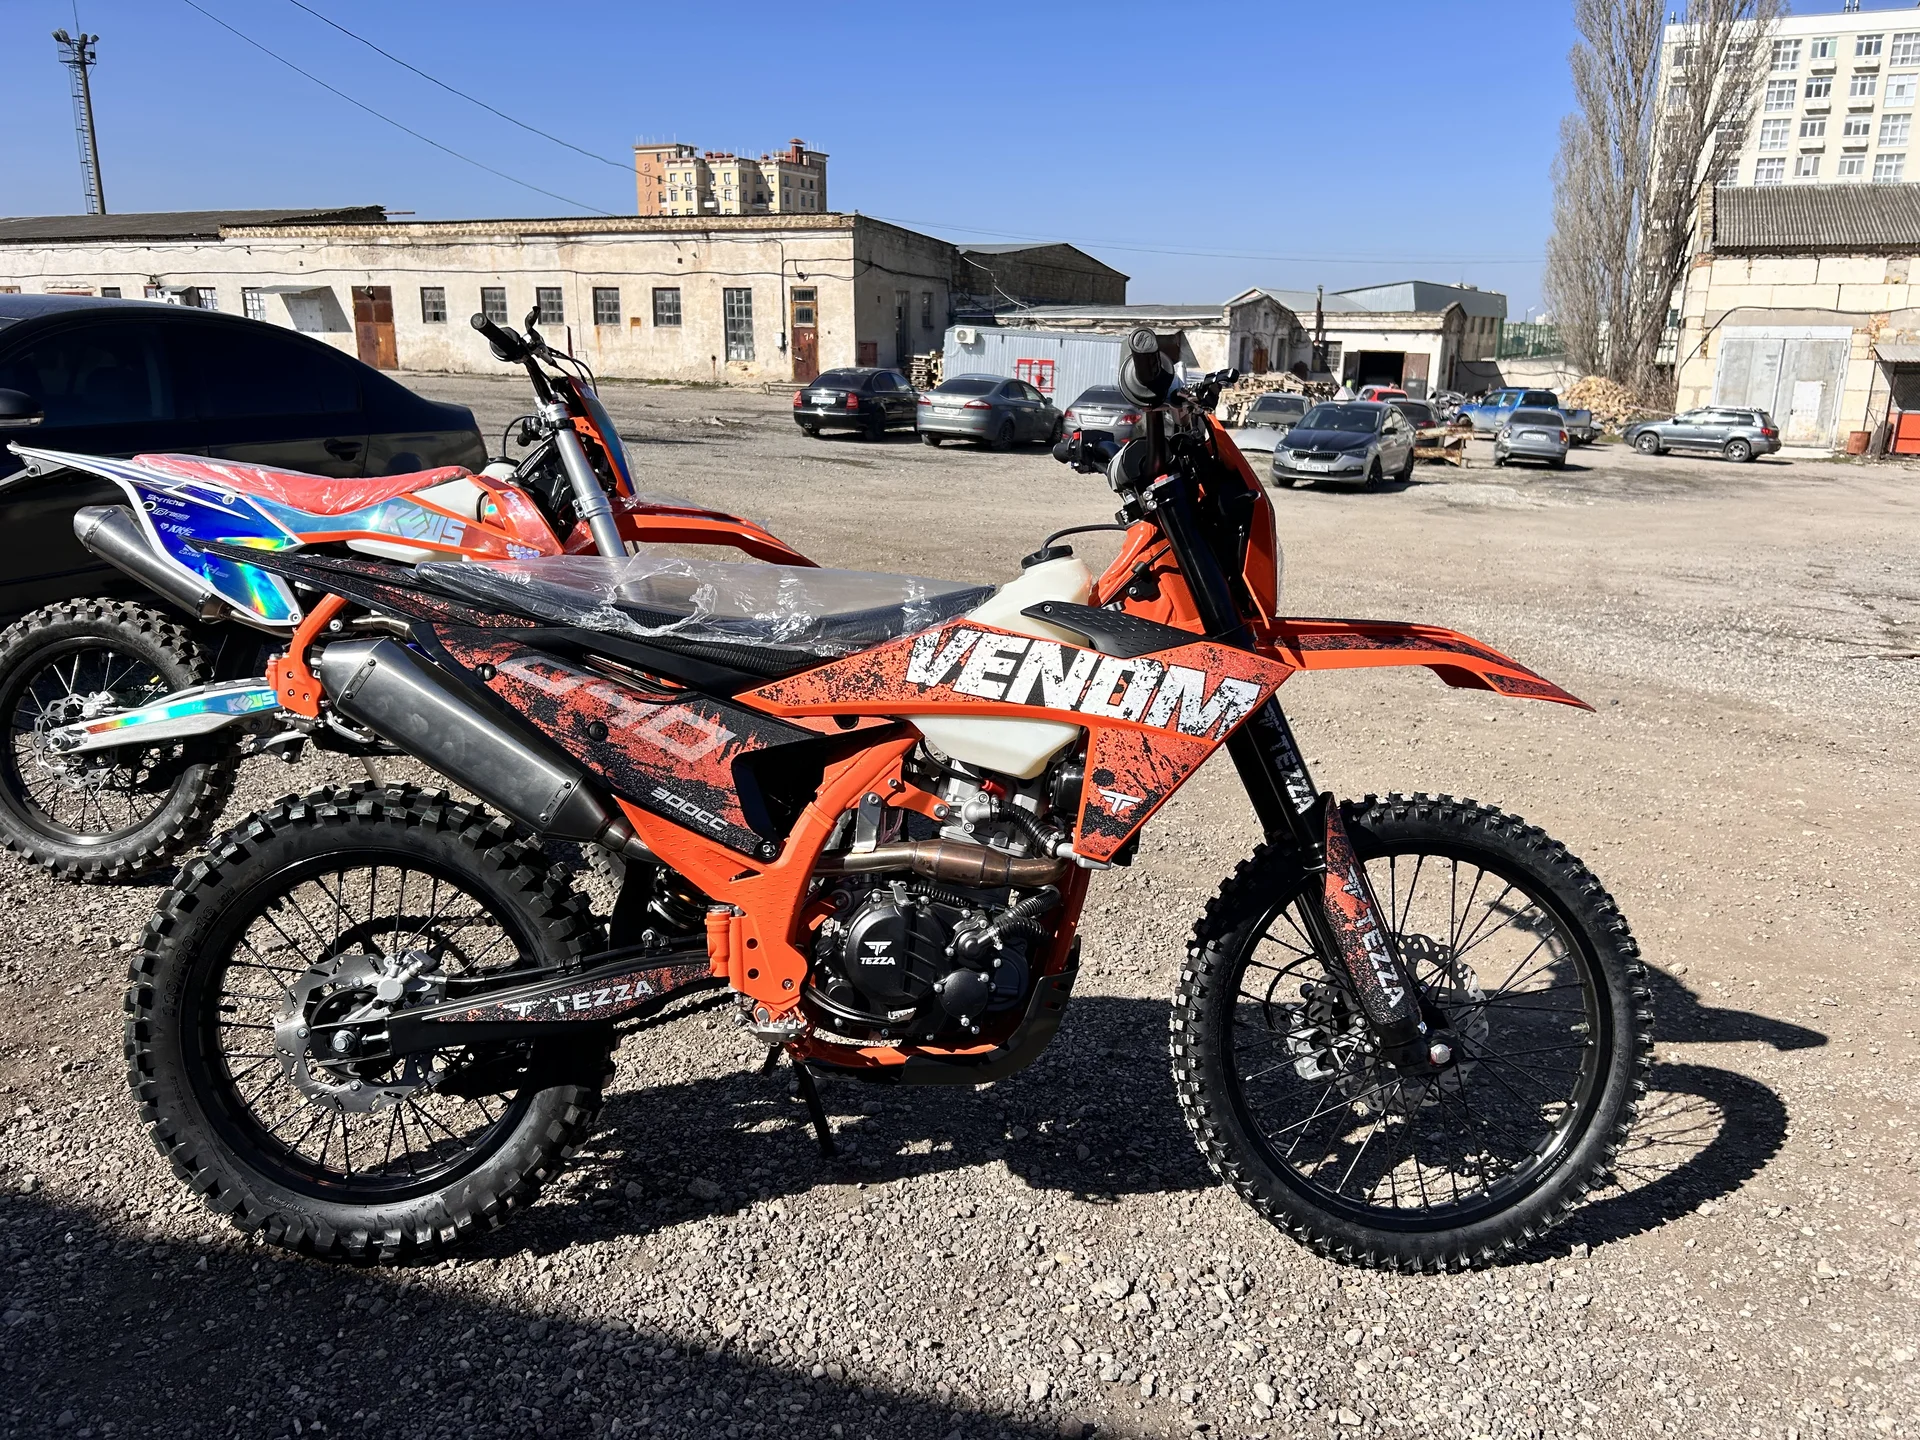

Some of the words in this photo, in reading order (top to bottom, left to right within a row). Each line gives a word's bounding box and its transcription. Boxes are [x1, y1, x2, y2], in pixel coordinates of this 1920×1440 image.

[905, 628, 1262, 742] VENOM
[1270, 734, 1316, 815] TEZZA
[650, 786, 729, 831] 300CC
[860, 956, 896, 966] TEZZA
[1355, 907, 1405, 1009] TEZZA
[549, 980, 655, 1013] TEZZA
